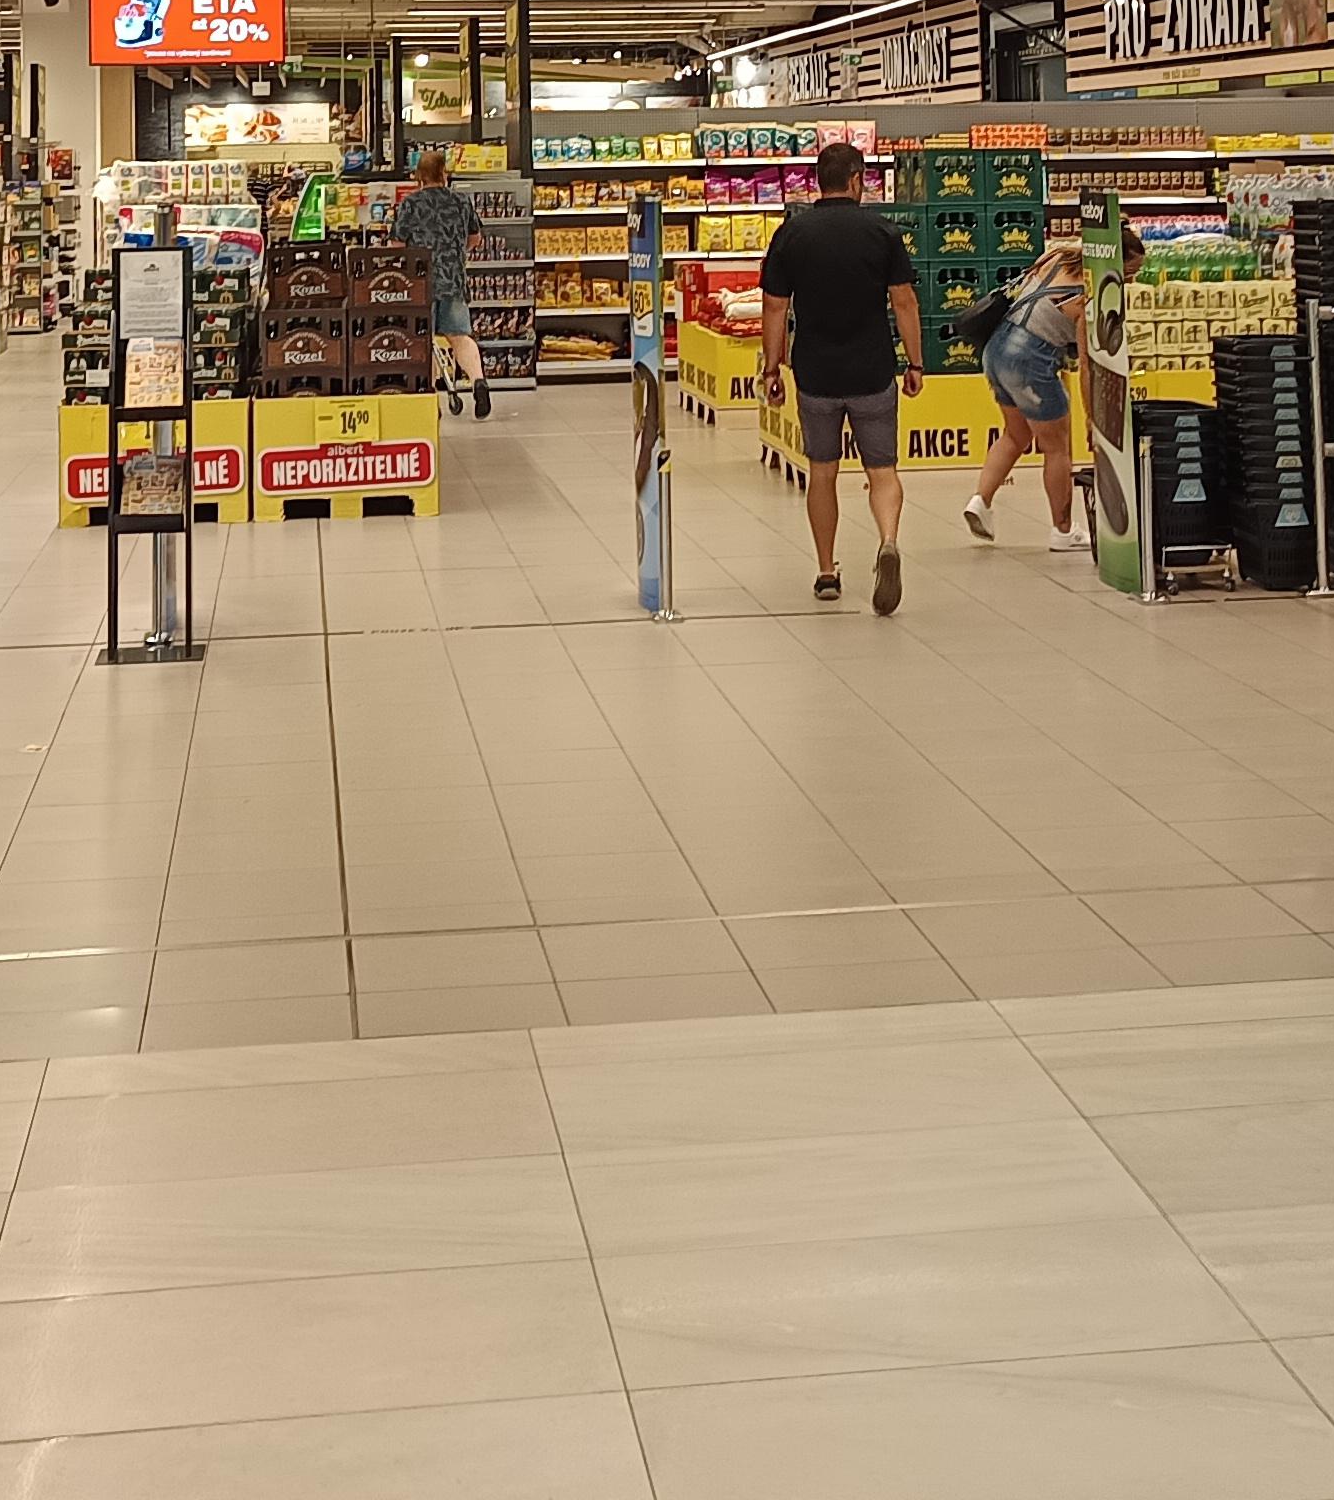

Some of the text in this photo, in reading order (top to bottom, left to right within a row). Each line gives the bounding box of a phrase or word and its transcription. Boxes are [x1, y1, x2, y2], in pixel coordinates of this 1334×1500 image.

[209, 18, 270, 43] 20%
[880, 20, 949, 90] DOMÁCNOST
[290, 283, 412, 303] Kozel Kozel
[284, 349, 412, 364] Kozel Kozel
[327, 443, 364, 457] albert
[908, 428, 969, 458] AKCE
[272, 448, 421, 487] NEPORAZITELNÉ
